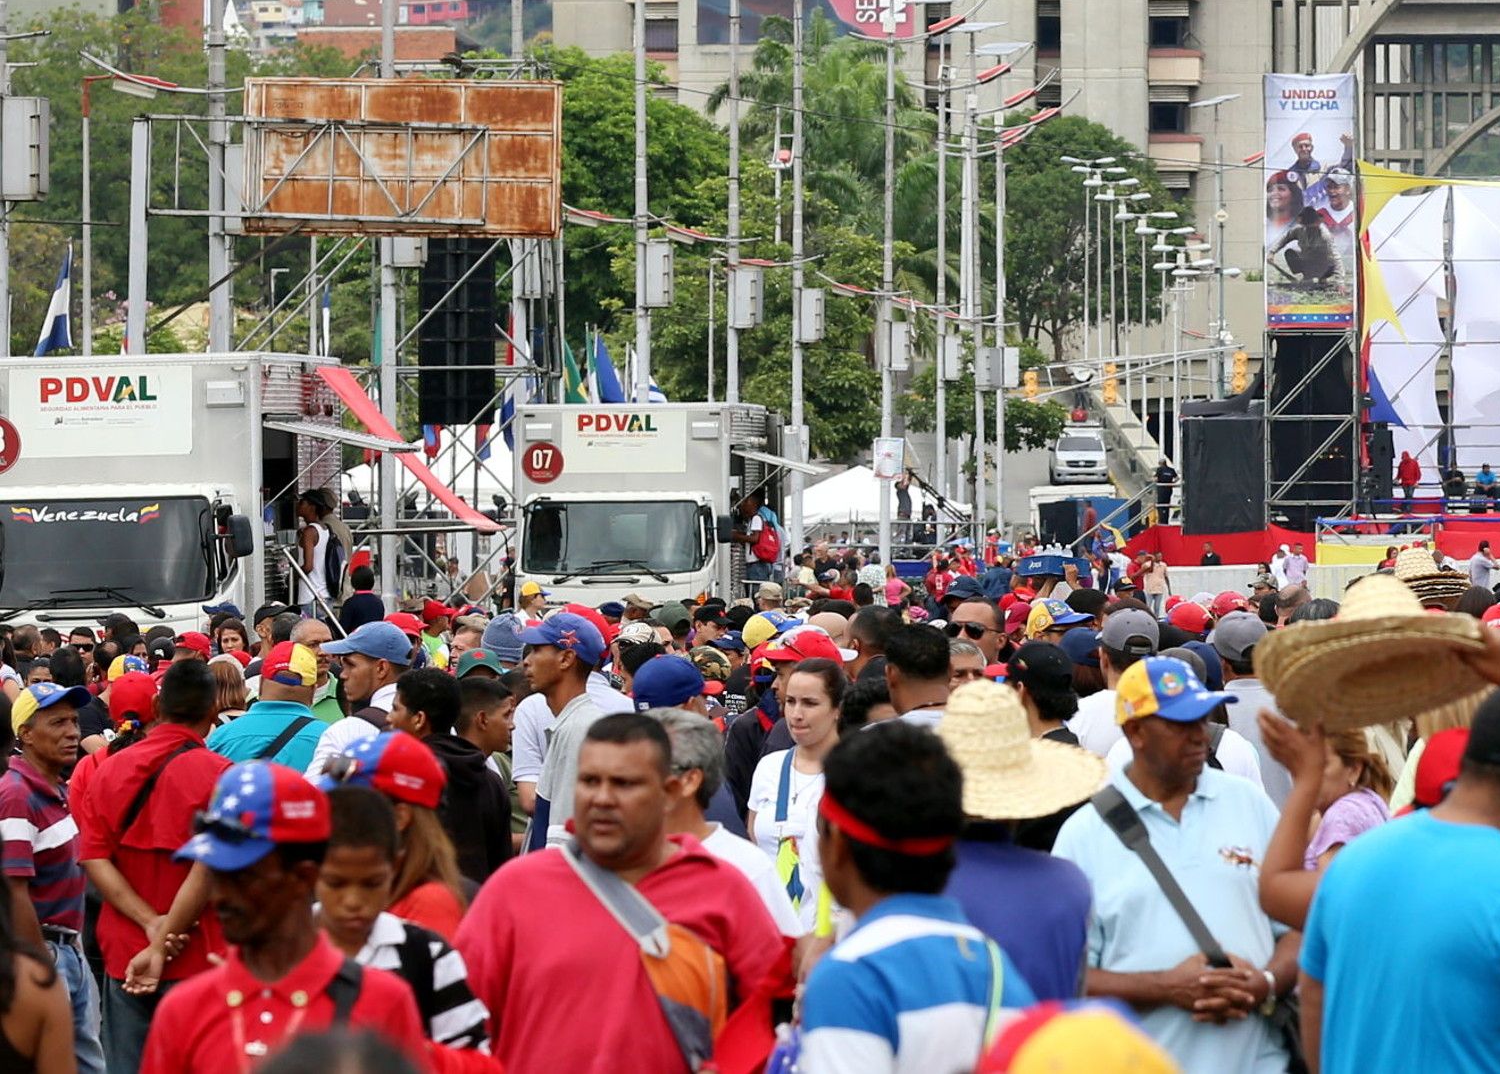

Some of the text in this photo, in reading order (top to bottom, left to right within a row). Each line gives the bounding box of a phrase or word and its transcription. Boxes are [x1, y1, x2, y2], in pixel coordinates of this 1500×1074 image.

[1281, 89, 1337, 99] UNIDAD
[1279, 100, 1340, 110] Y LUCHA
[40, 375, 158, 404] PDVAL
[577, 413, 658, 433] PDVAL
[532, 449, 553, 470] 07
[31, 505, 139, 523] Venezuela
